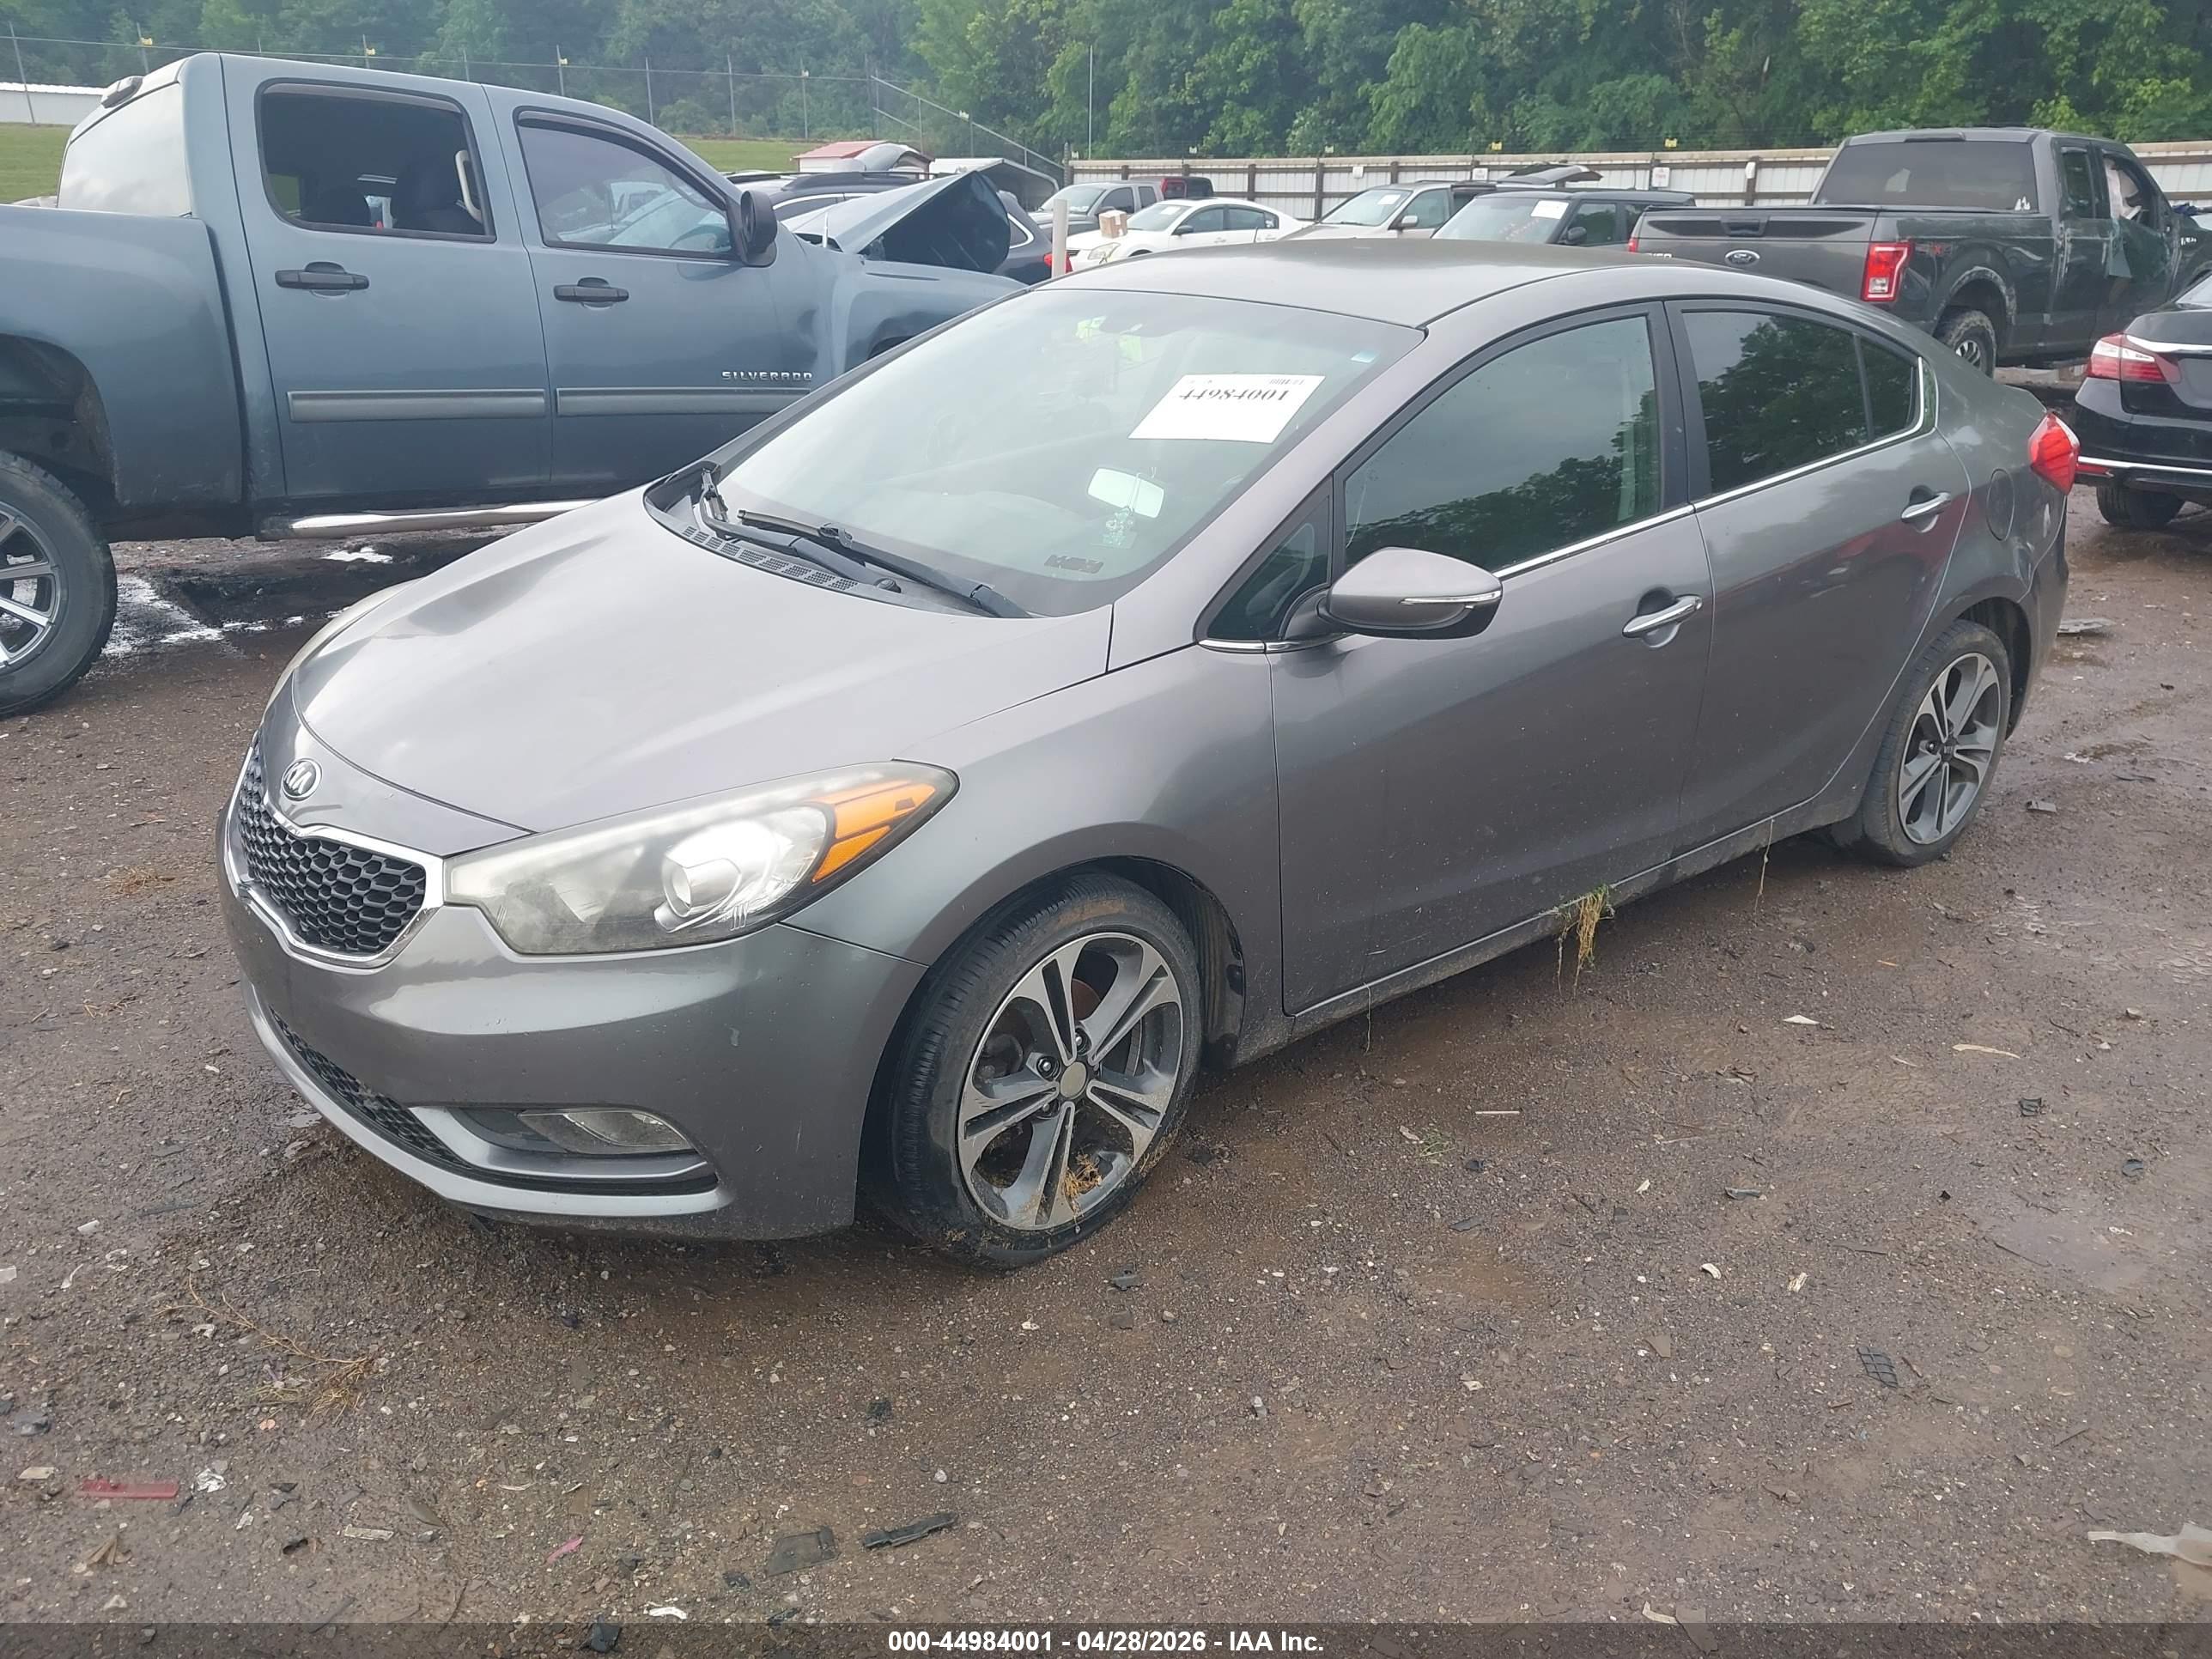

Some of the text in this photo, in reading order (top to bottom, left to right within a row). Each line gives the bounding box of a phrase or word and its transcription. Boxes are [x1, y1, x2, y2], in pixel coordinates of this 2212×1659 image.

[721, 370, 813, 381] SILVERADO
[1179, 388, 1291, 402] 44984001
[284, 762, 313, 794] KIA
